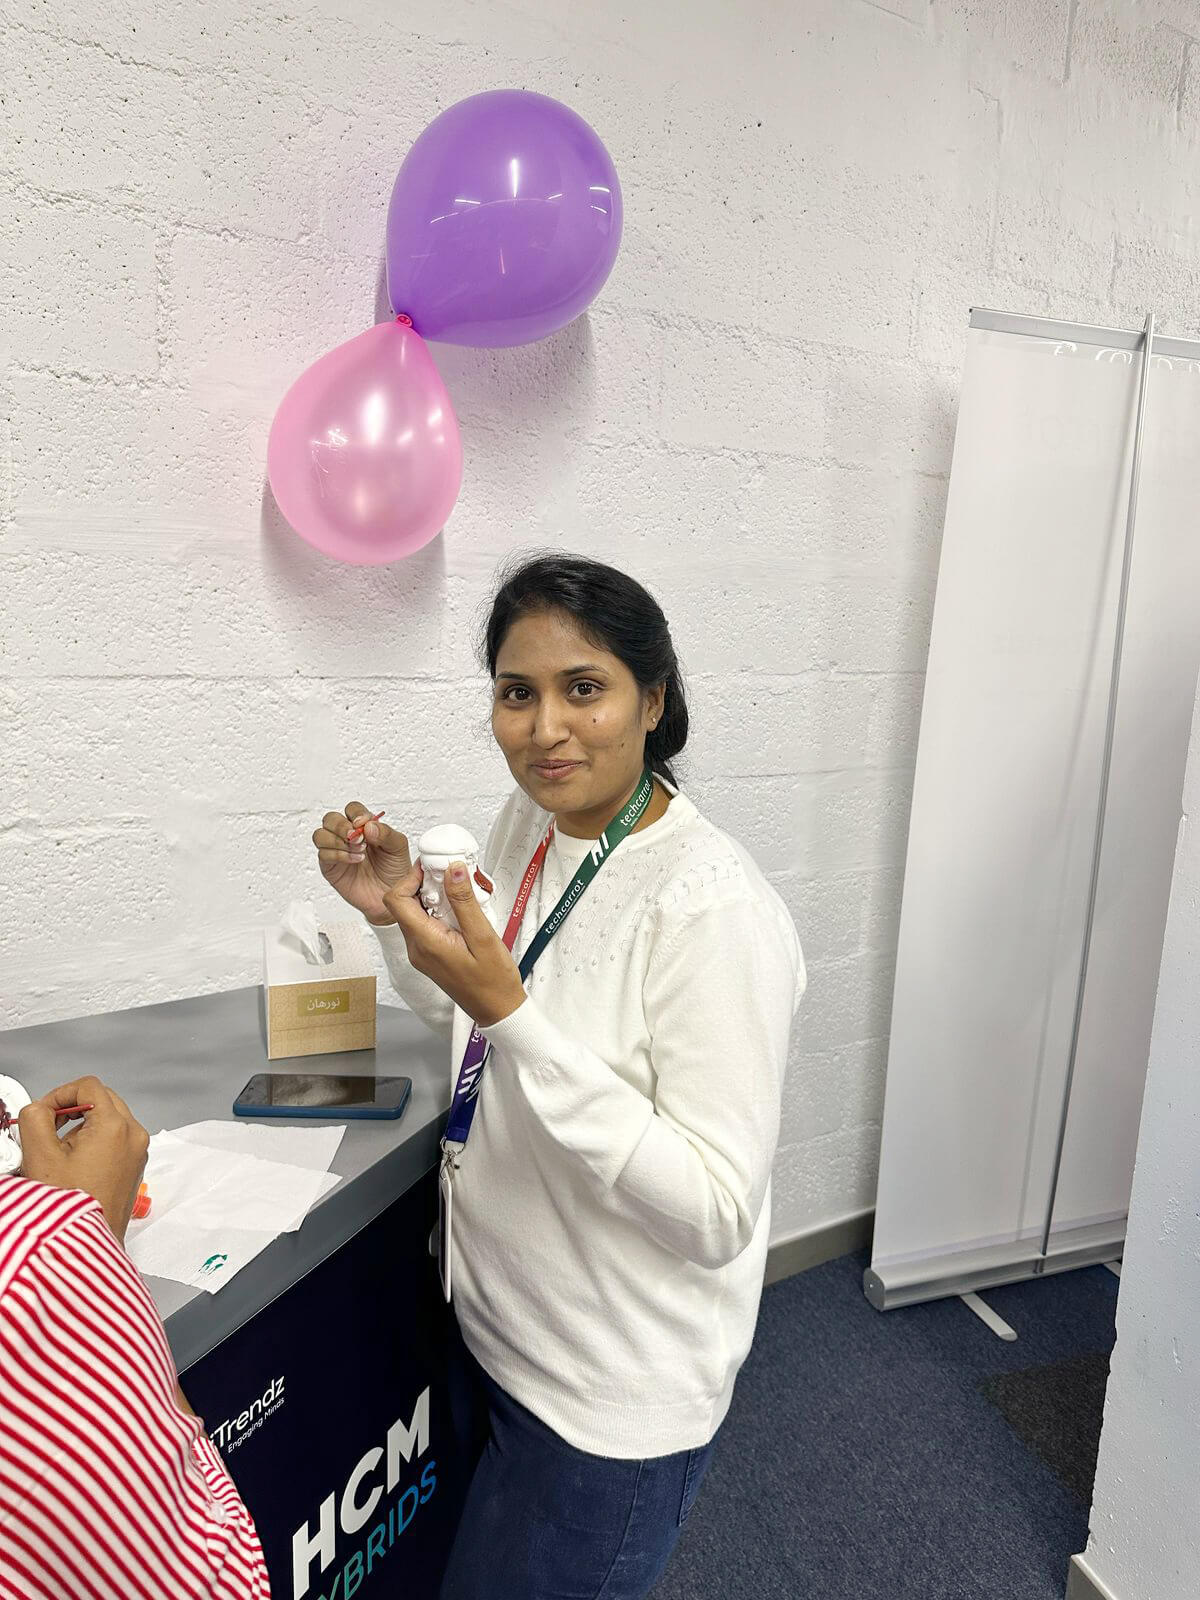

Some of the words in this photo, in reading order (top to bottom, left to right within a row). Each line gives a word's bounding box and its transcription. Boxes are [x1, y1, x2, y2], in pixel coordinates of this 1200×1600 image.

[620, 779, 651, 826] techcarrot
[513, 863, 537, 918] techcarrot
[545, 879, 584, 934] techcarrot
[228, 1417, 263, 1453] Engaging
[264, 1397, 285, 1420] Minds
[293, 1385, 430, 1600] HCM
